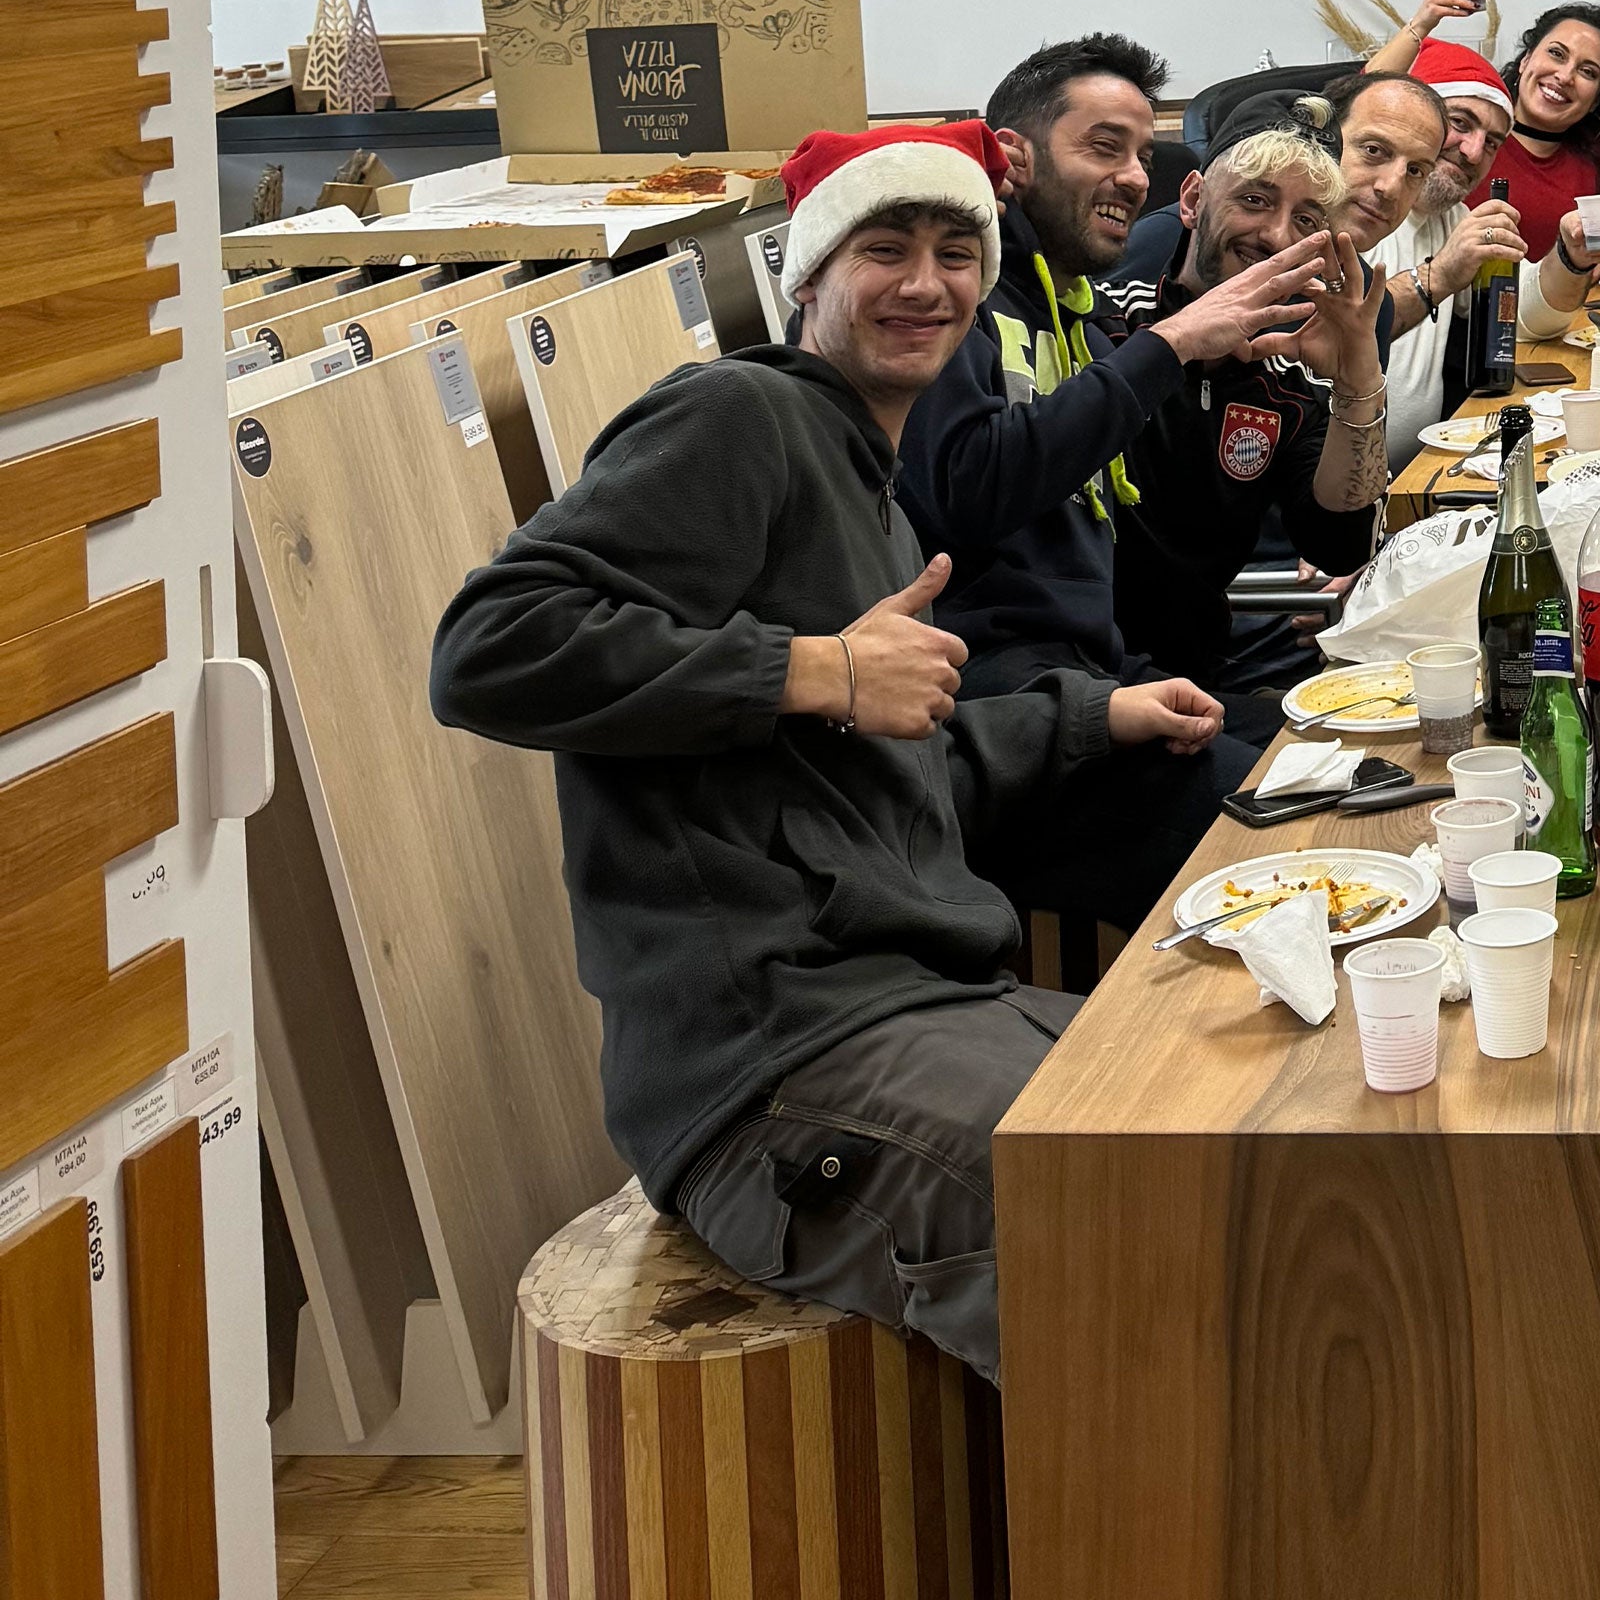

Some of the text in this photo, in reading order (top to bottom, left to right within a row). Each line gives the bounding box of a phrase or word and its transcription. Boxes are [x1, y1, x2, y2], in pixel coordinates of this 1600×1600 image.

[622, 40, 676, 68] PIZZA
[618, 63, 702, 102] BUONA
[623, 112, 689, 128] GUSTO DELLA
[639, 127, 680, 141] TUTTO IL
[1228, 428, 1268, 452] FC BAYERN
[199, 1106, 242, 1148] 43,99
[54, 1135, 88, 1166] MTA14A
[58, 1151, 86, 1178] €84,00
[86, 1199, 105, 1282] €59,99
